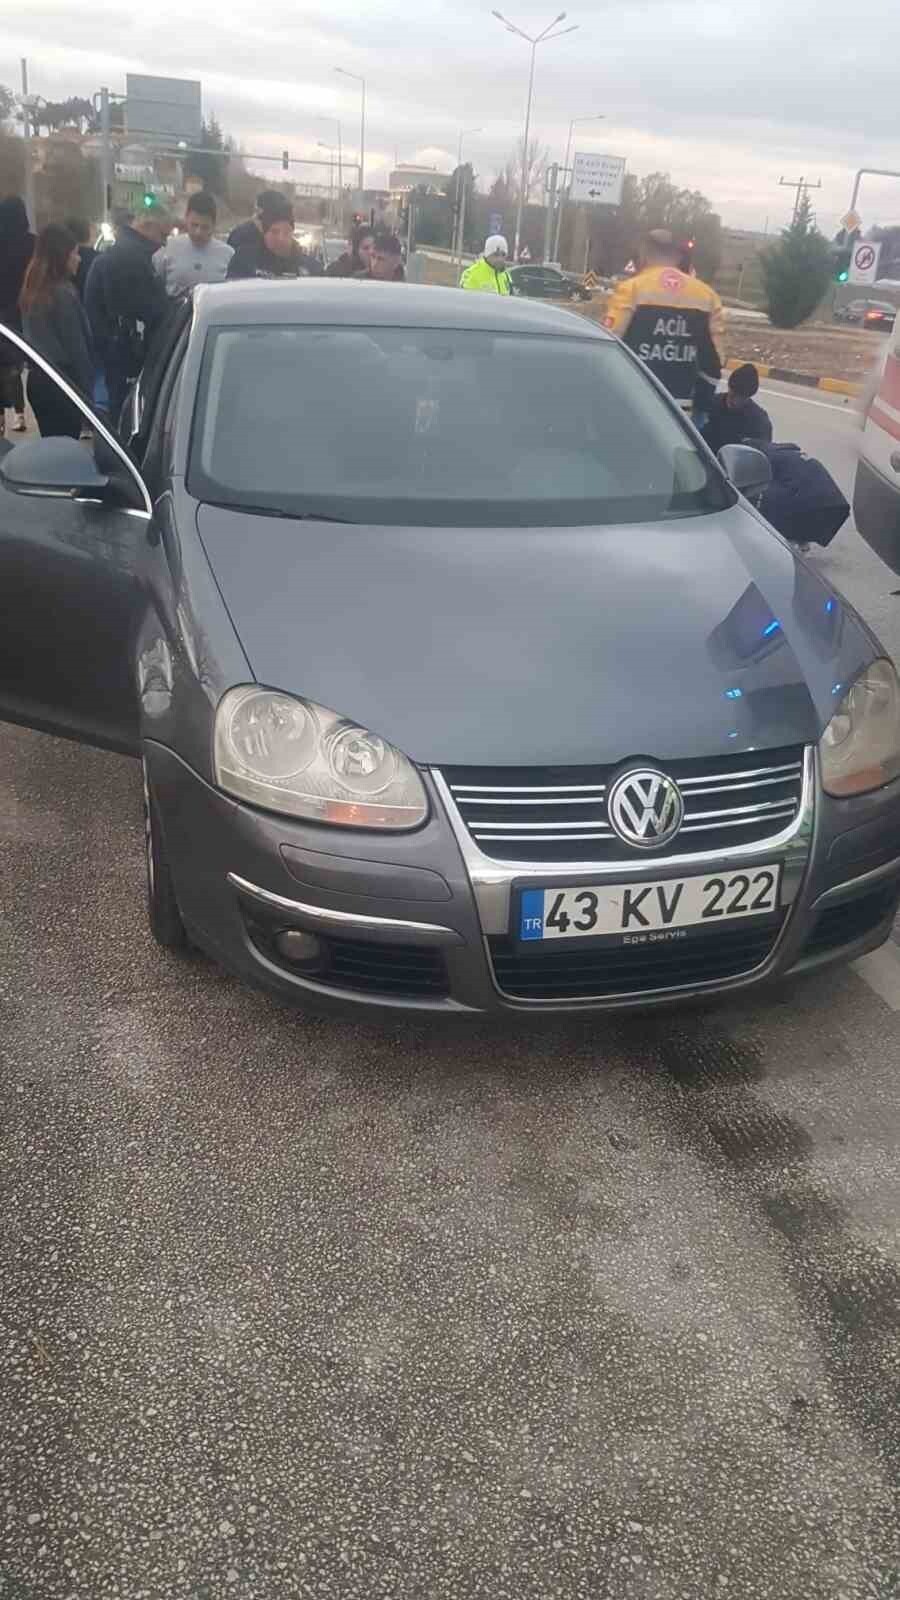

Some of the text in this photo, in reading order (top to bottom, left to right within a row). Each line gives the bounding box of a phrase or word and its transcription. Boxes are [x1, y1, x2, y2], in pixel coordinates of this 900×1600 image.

[653, 315, 691, 337] ACİL
[524, 870, 774, 932] TR 43 KV 222
